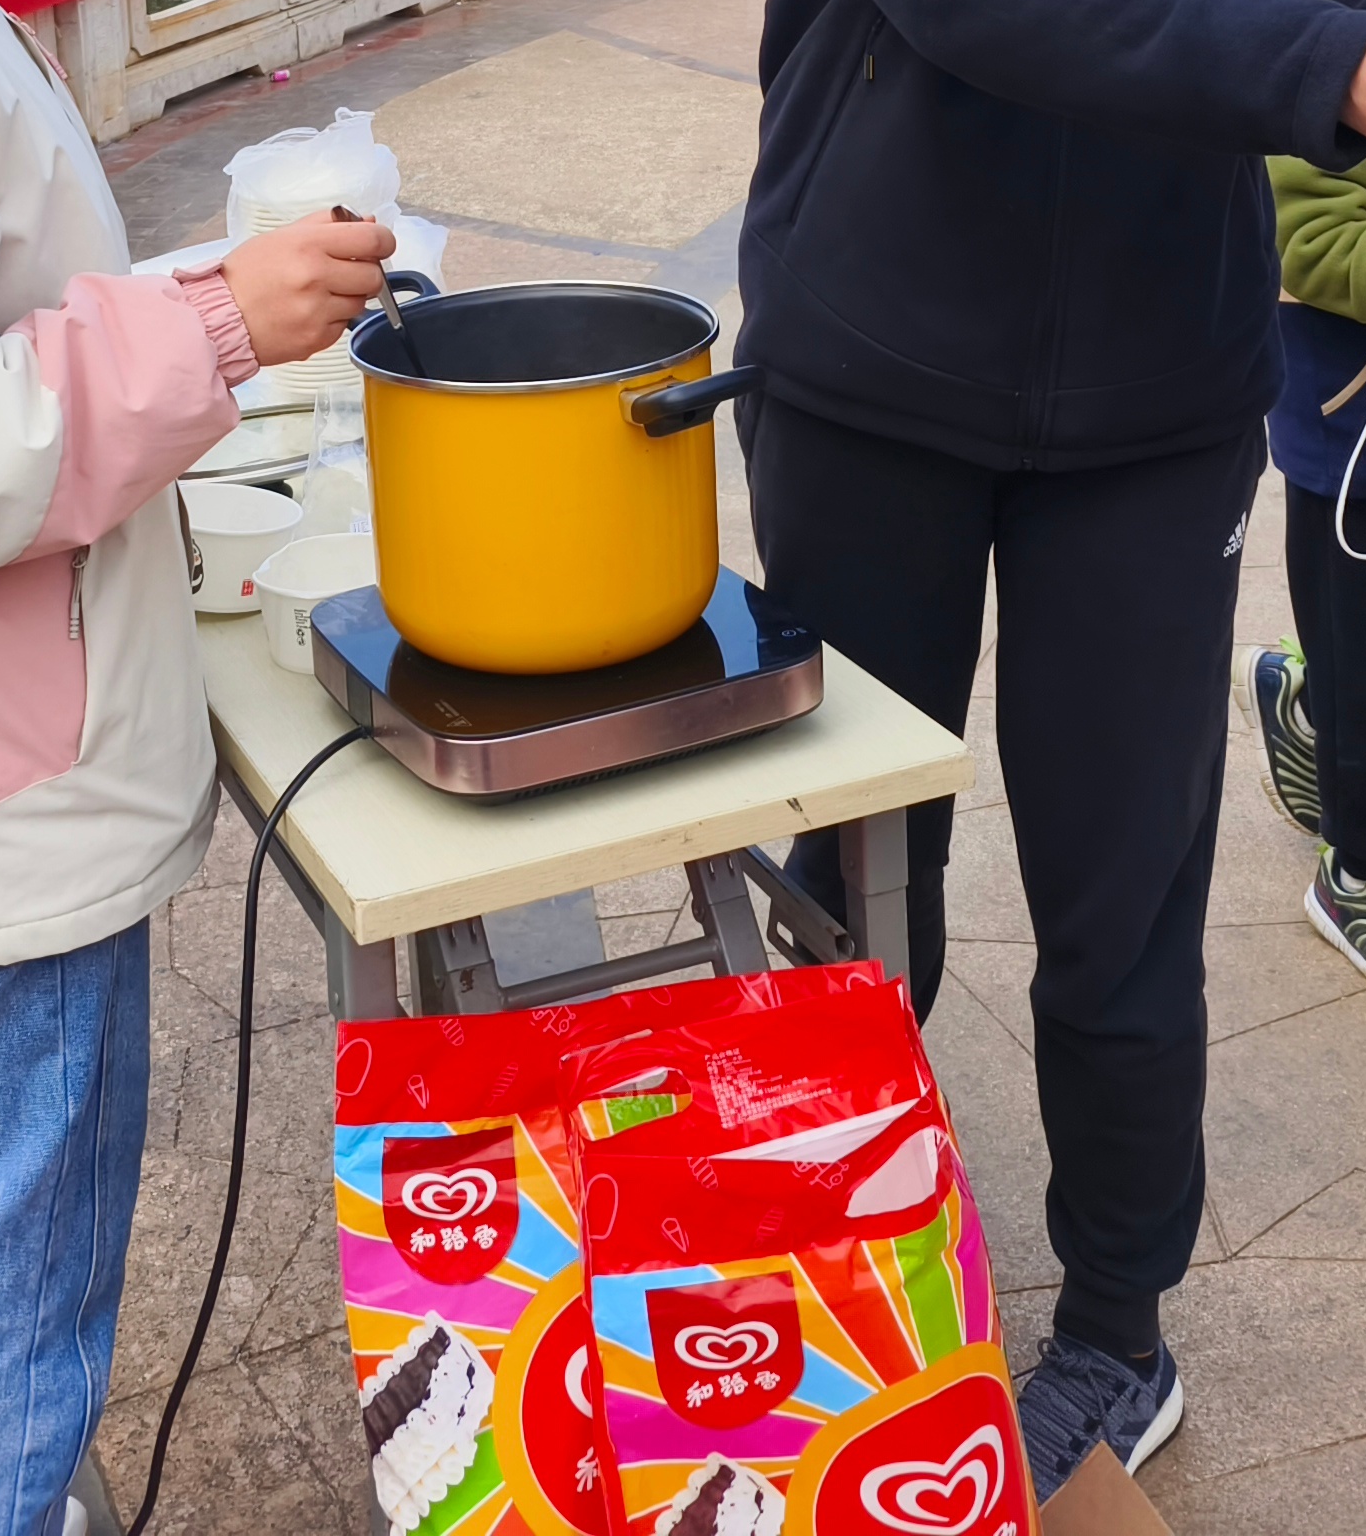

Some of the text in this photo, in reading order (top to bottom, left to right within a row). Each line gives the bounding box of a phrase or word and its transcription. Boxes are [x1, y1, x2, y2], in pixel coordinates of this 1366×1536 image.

[410, 1224, 498, 1254] 和路雪
[686, 1370, 781, 1408] 和路雪
